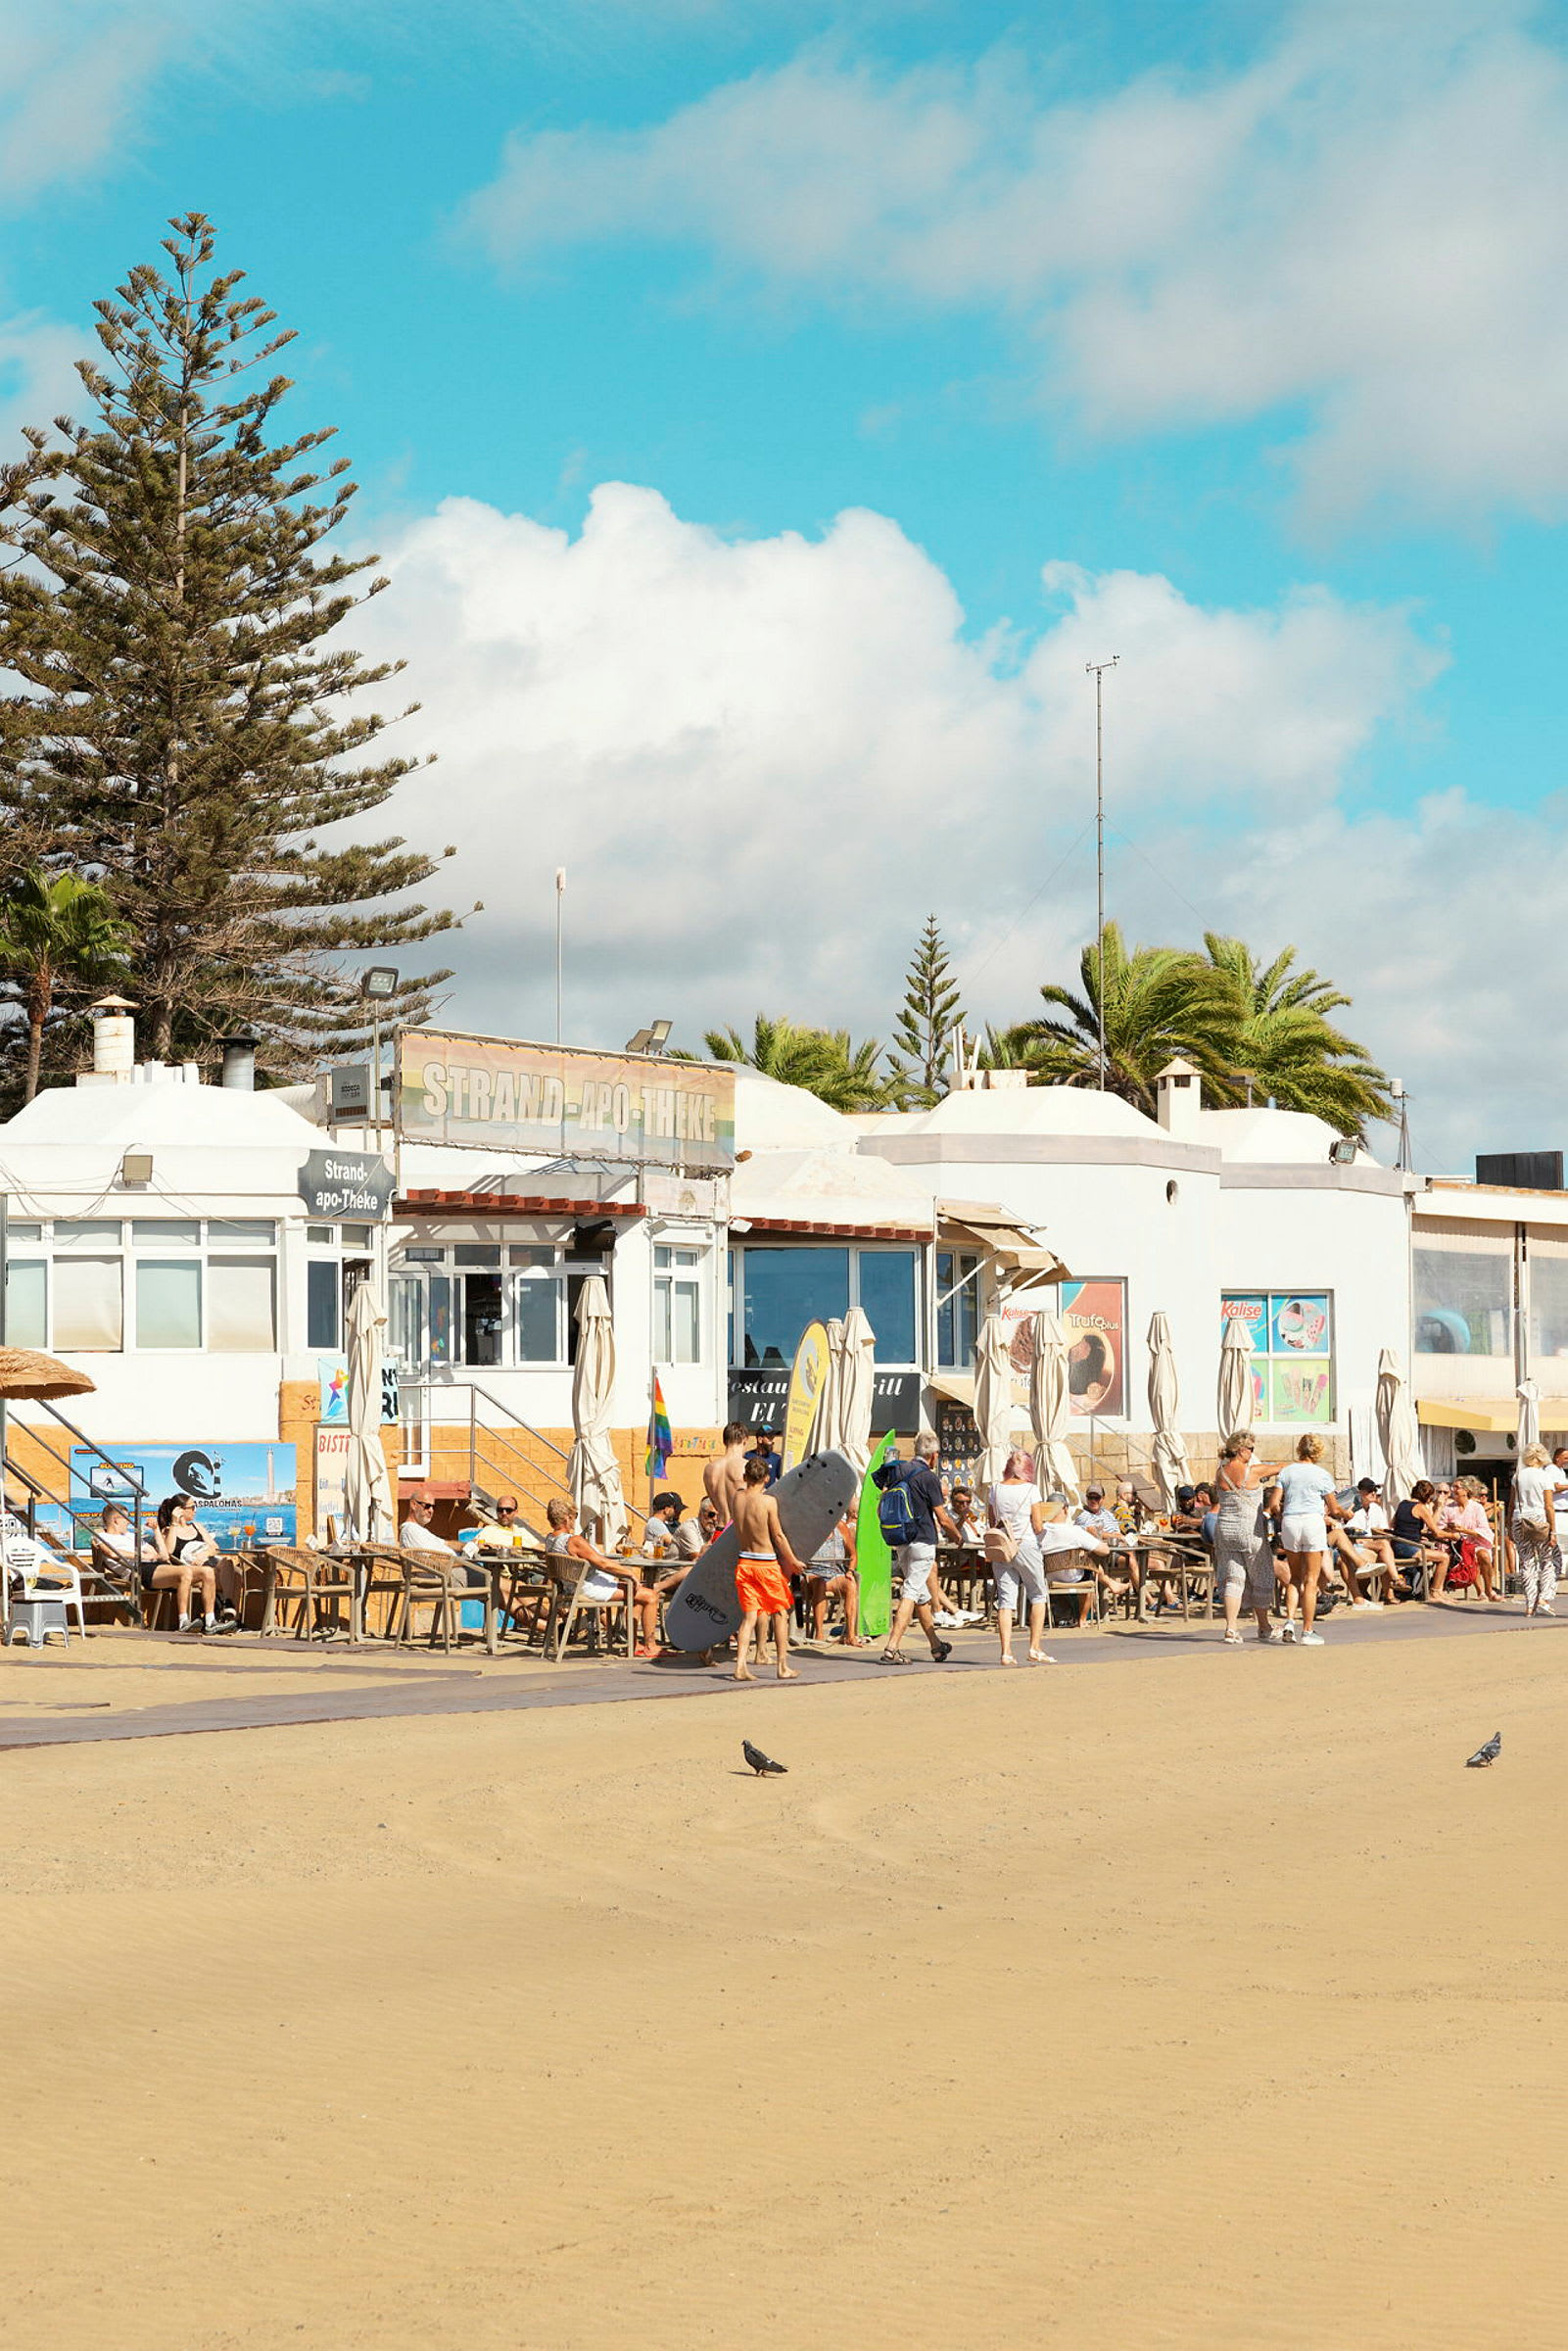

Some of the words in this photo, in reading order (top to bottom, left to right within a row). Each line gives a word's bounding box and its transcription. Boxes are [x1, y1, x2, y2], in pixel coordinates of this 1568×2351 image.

[325, 1159, 367, 1181] Strand-
[315, 1187, 378, 1211] apo-Theke
[1221, 1300, 1261, 1319] Kalise
[750, 1403, 776, 1421] El
